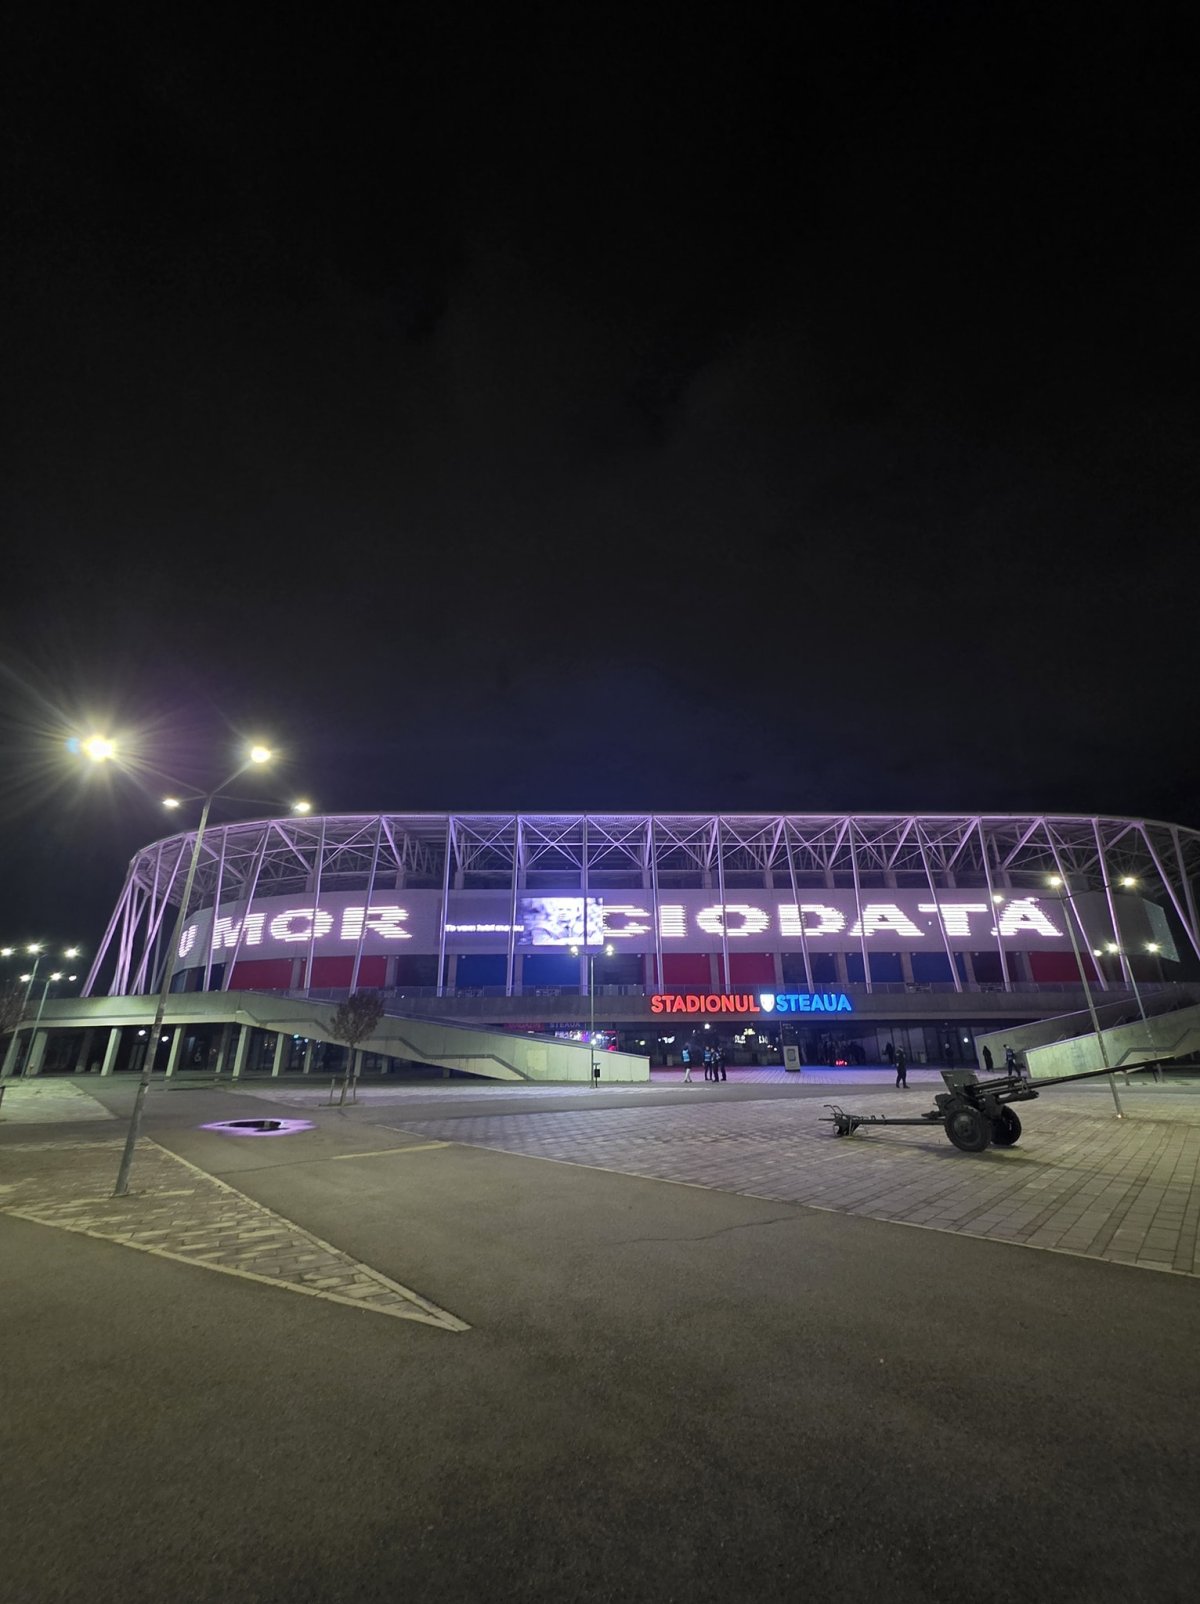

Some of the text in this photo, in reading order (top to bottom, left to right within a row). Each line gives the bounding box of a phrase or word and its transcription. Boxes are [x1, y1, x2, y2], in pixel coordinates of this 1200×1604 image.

[212, 905, 412, 949] MOR
[651, 993, 852, 1013] STADIONUL STEAUA
